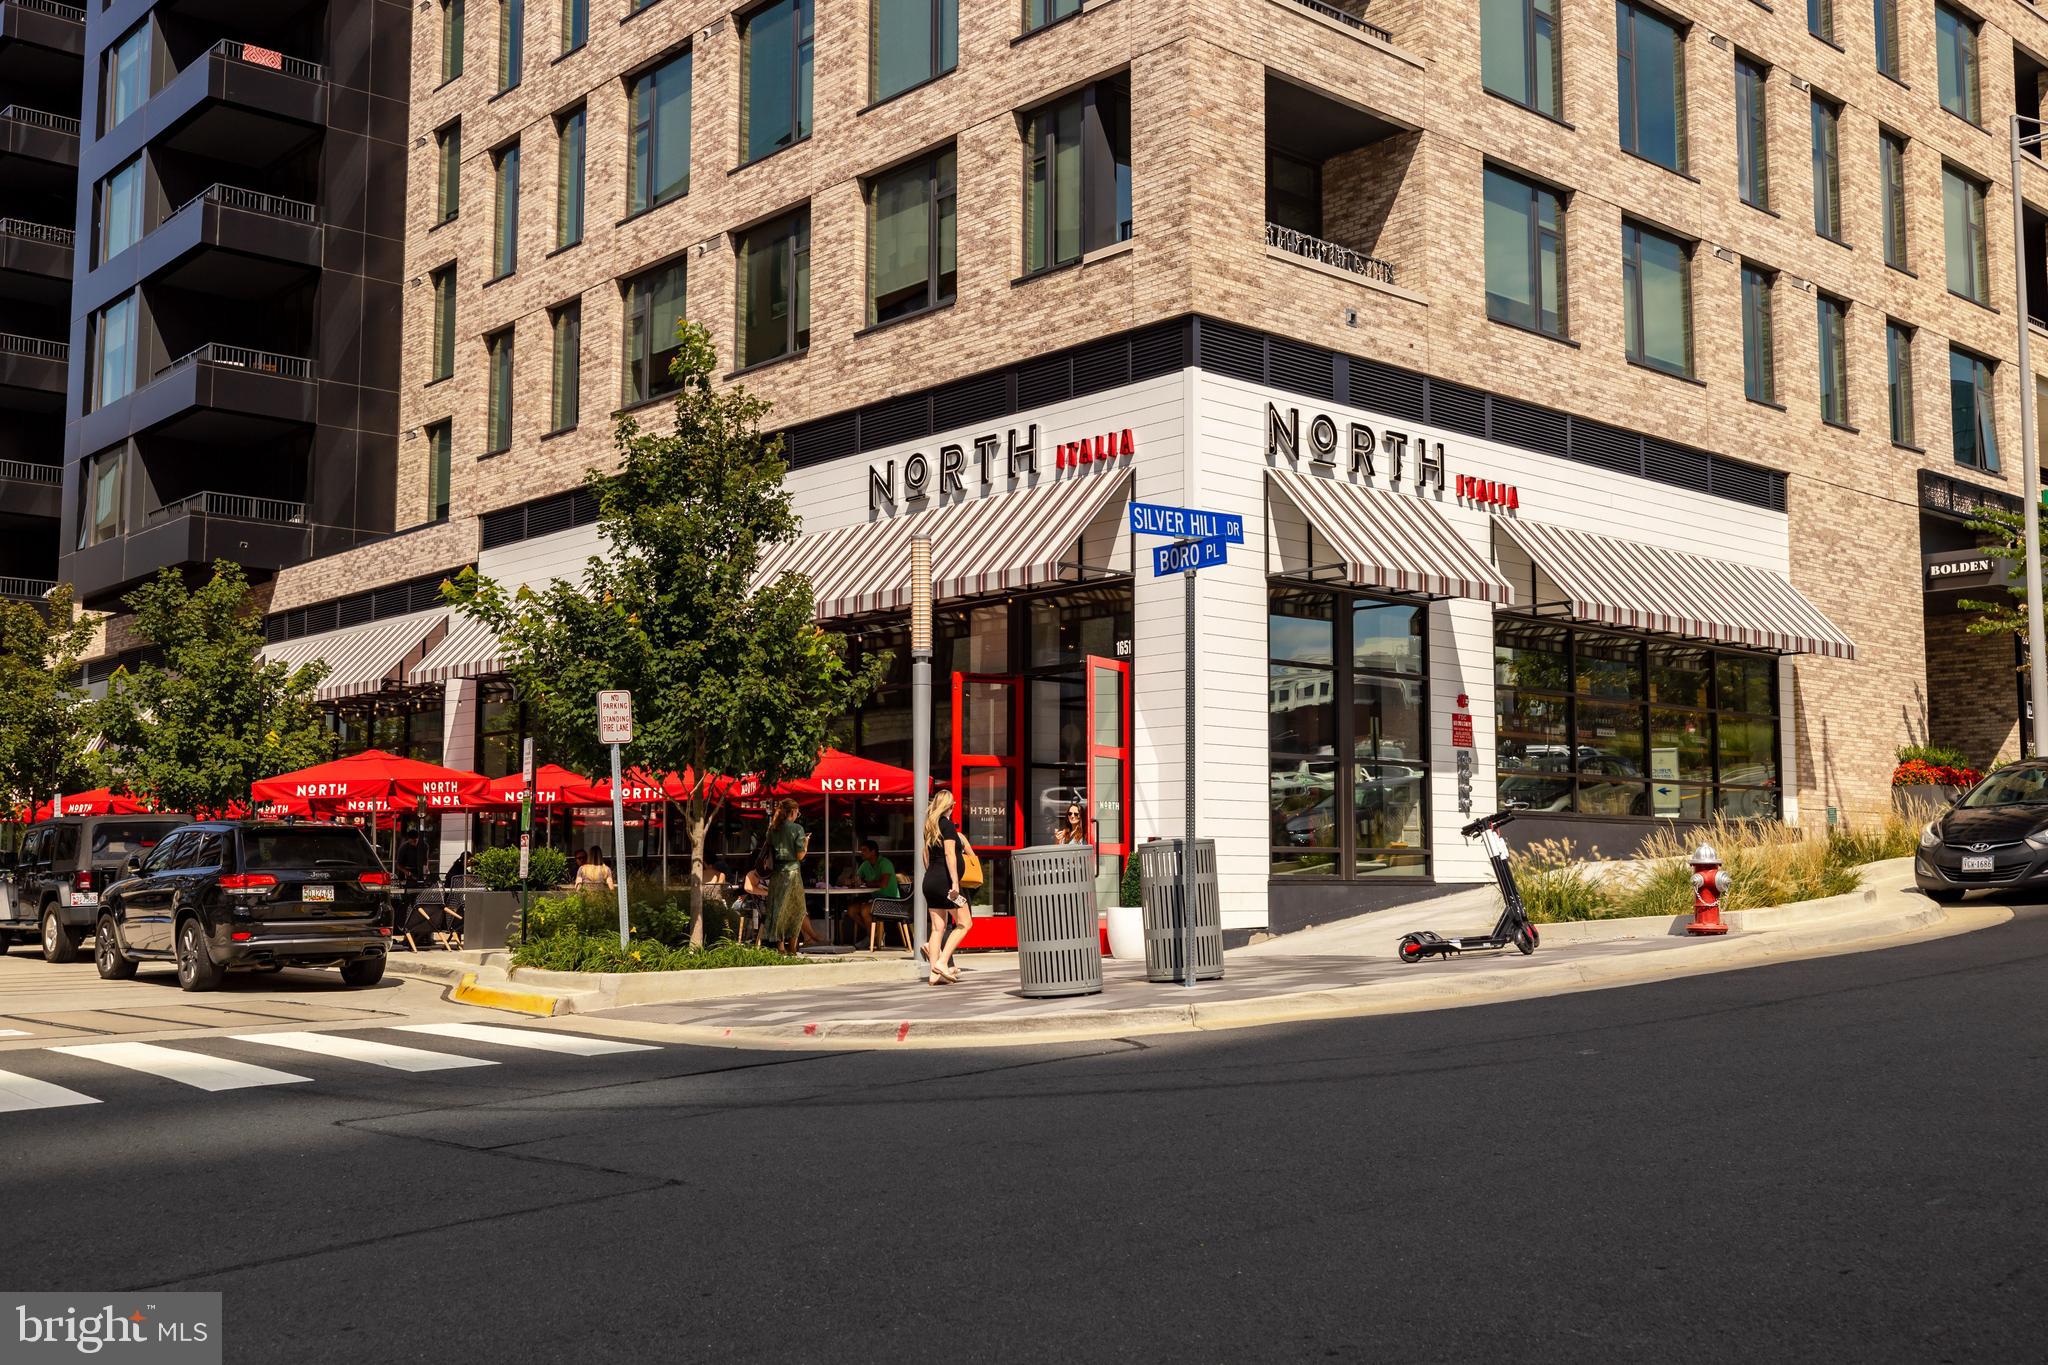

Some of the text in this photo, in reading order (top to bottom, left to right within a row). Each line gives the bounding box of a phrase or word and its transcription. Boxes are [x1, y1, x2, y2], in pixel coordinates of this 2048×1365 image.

[1264, 401, 1519, 510] NORTH ITALIA
[869, 423, 1135, 510] NORTH ITALIA
[1134, 507, 1240, 537] SILVER HILL DR
[1160, 543, 1220, 572] BORO PL
[1930, 560, 1989, 576] BOLDEN
[1116, 640, 1132, 656] 1651
[610, 694, 619, 702] NO
[603, 702, 628, 710] PARKING
[602, 715, 629, 723] STANDING
[603, 723, 630, 732] FIRE LANE
[296, 783, 347, 797] NORTH
[422, 781, 458, 794] NORTH
[821, 778, 880, 792] NORTH
[505, 791, 556, 802] NOTH
[68, 803, 93, 813] NORTH
[310, 871, 330, 879] Jeep
